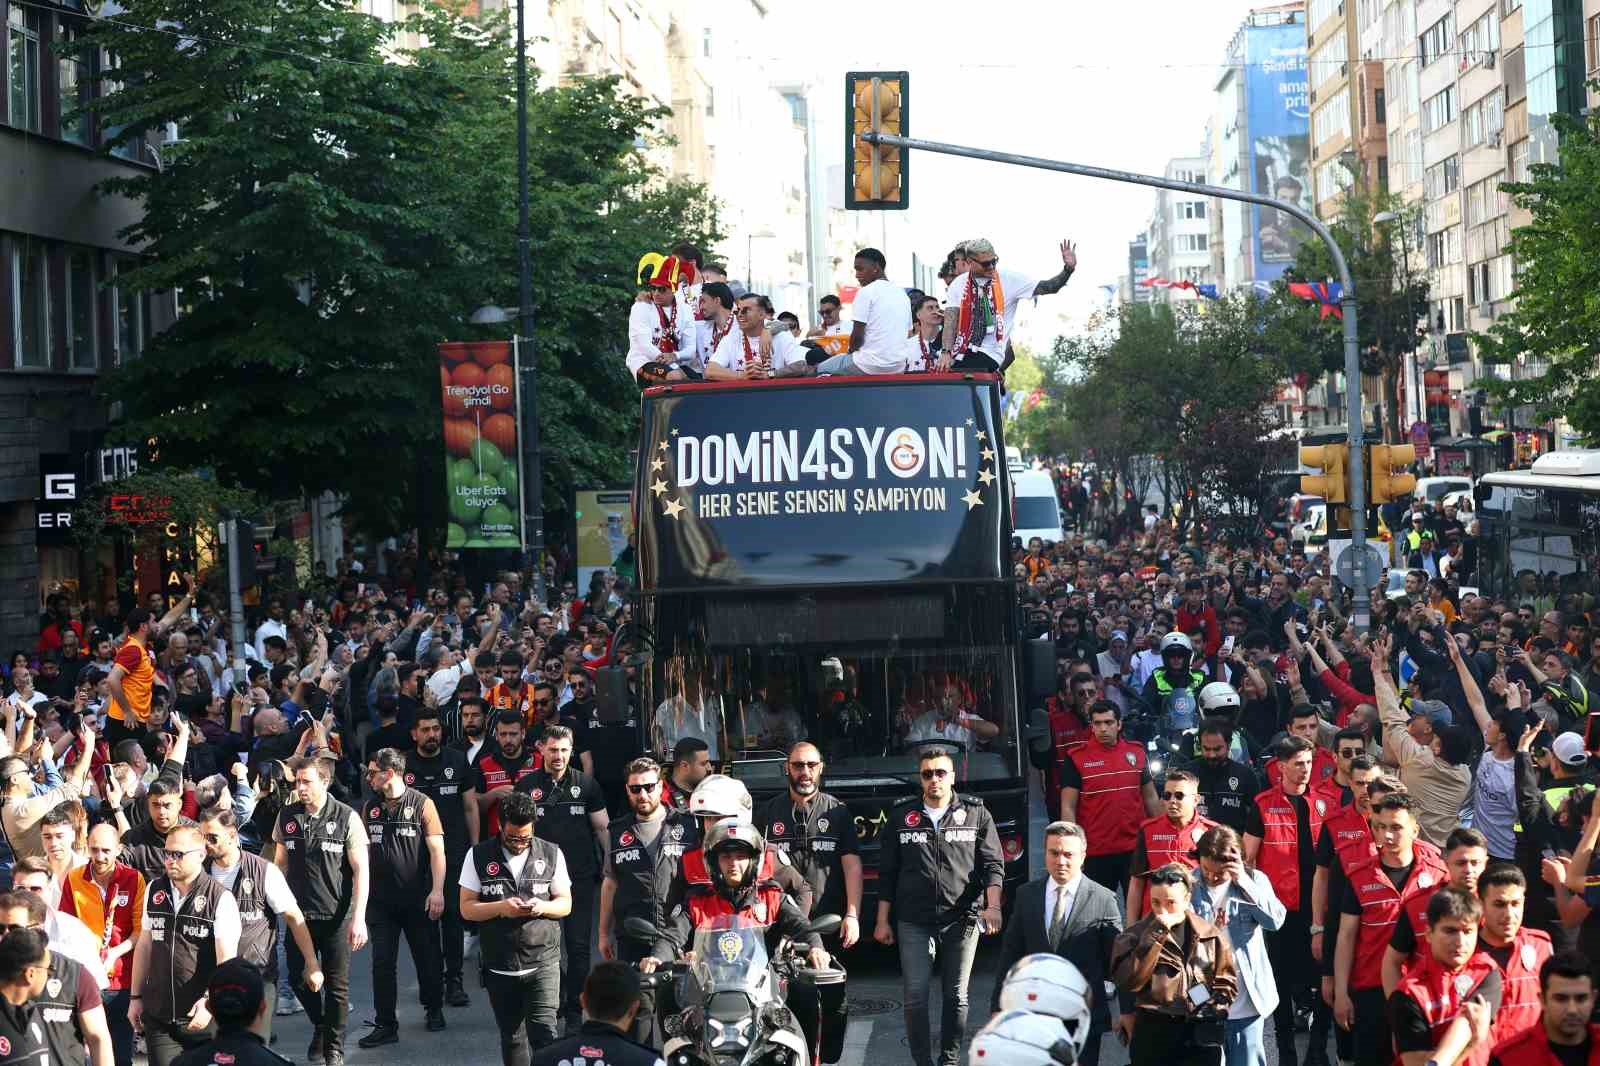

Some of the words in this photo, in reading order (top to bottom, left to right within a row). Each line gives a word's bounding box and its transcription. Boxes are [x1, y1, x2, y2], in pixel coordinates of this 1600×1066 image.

[445, 384, 491, 398] Trendyol
[492, 383, 509, 395] Go
[463, 395, 492, 409] şimdi
[456, 485, 482, 497] Uber
[483, 484, 507, 496] Eats
[464, 496, 498, 508] oluyor
[699, 493, 731, 519] HER
[735, 491, 779, 517] SENE
[899, 831, 929, 844] SPOR
[615, 848, 641, 865] SPOR
